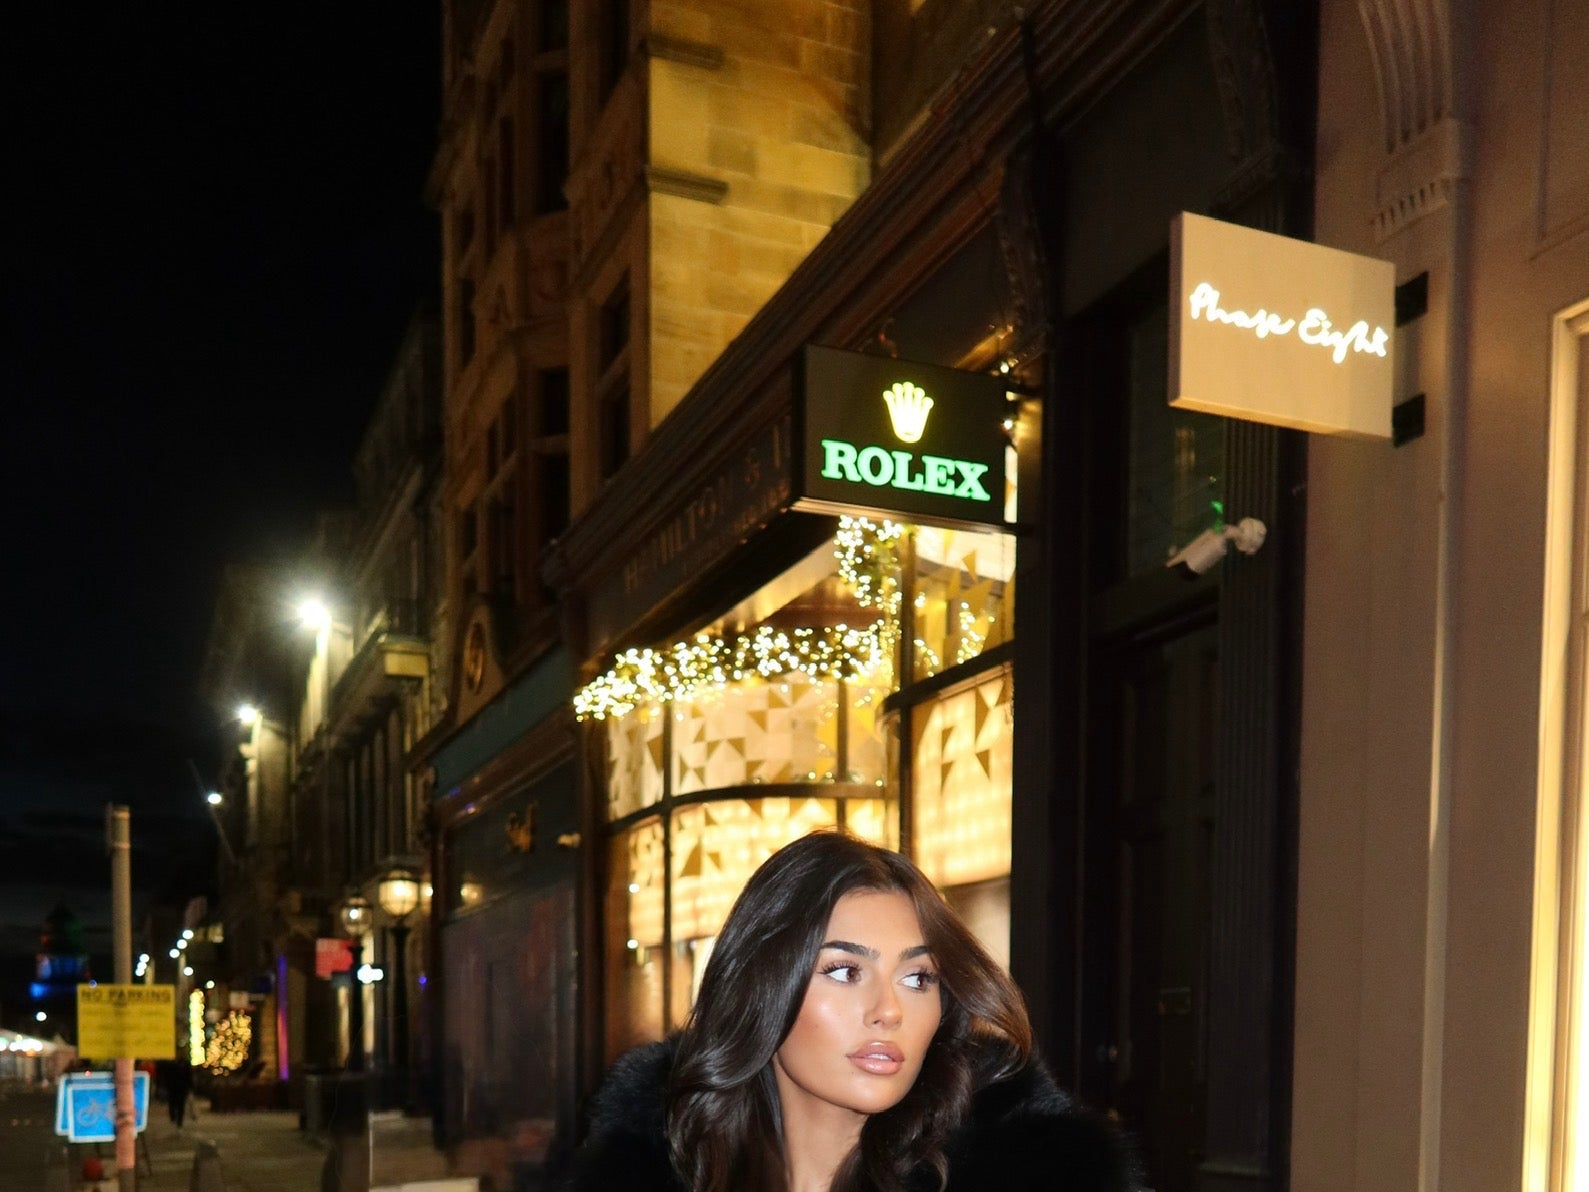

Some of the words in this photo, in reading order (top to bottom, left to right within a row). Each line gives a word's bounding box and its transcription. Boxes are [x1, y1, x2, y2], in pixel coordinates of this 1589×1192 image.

[1189, 282, 1296, 338] Phase
[1298, 308, 1389, 364] Eight
[821, 439, 991, 501] ROLEX
[81, 989, 102, 1003] NO
[108, 988, 171, 1003] PARKING
